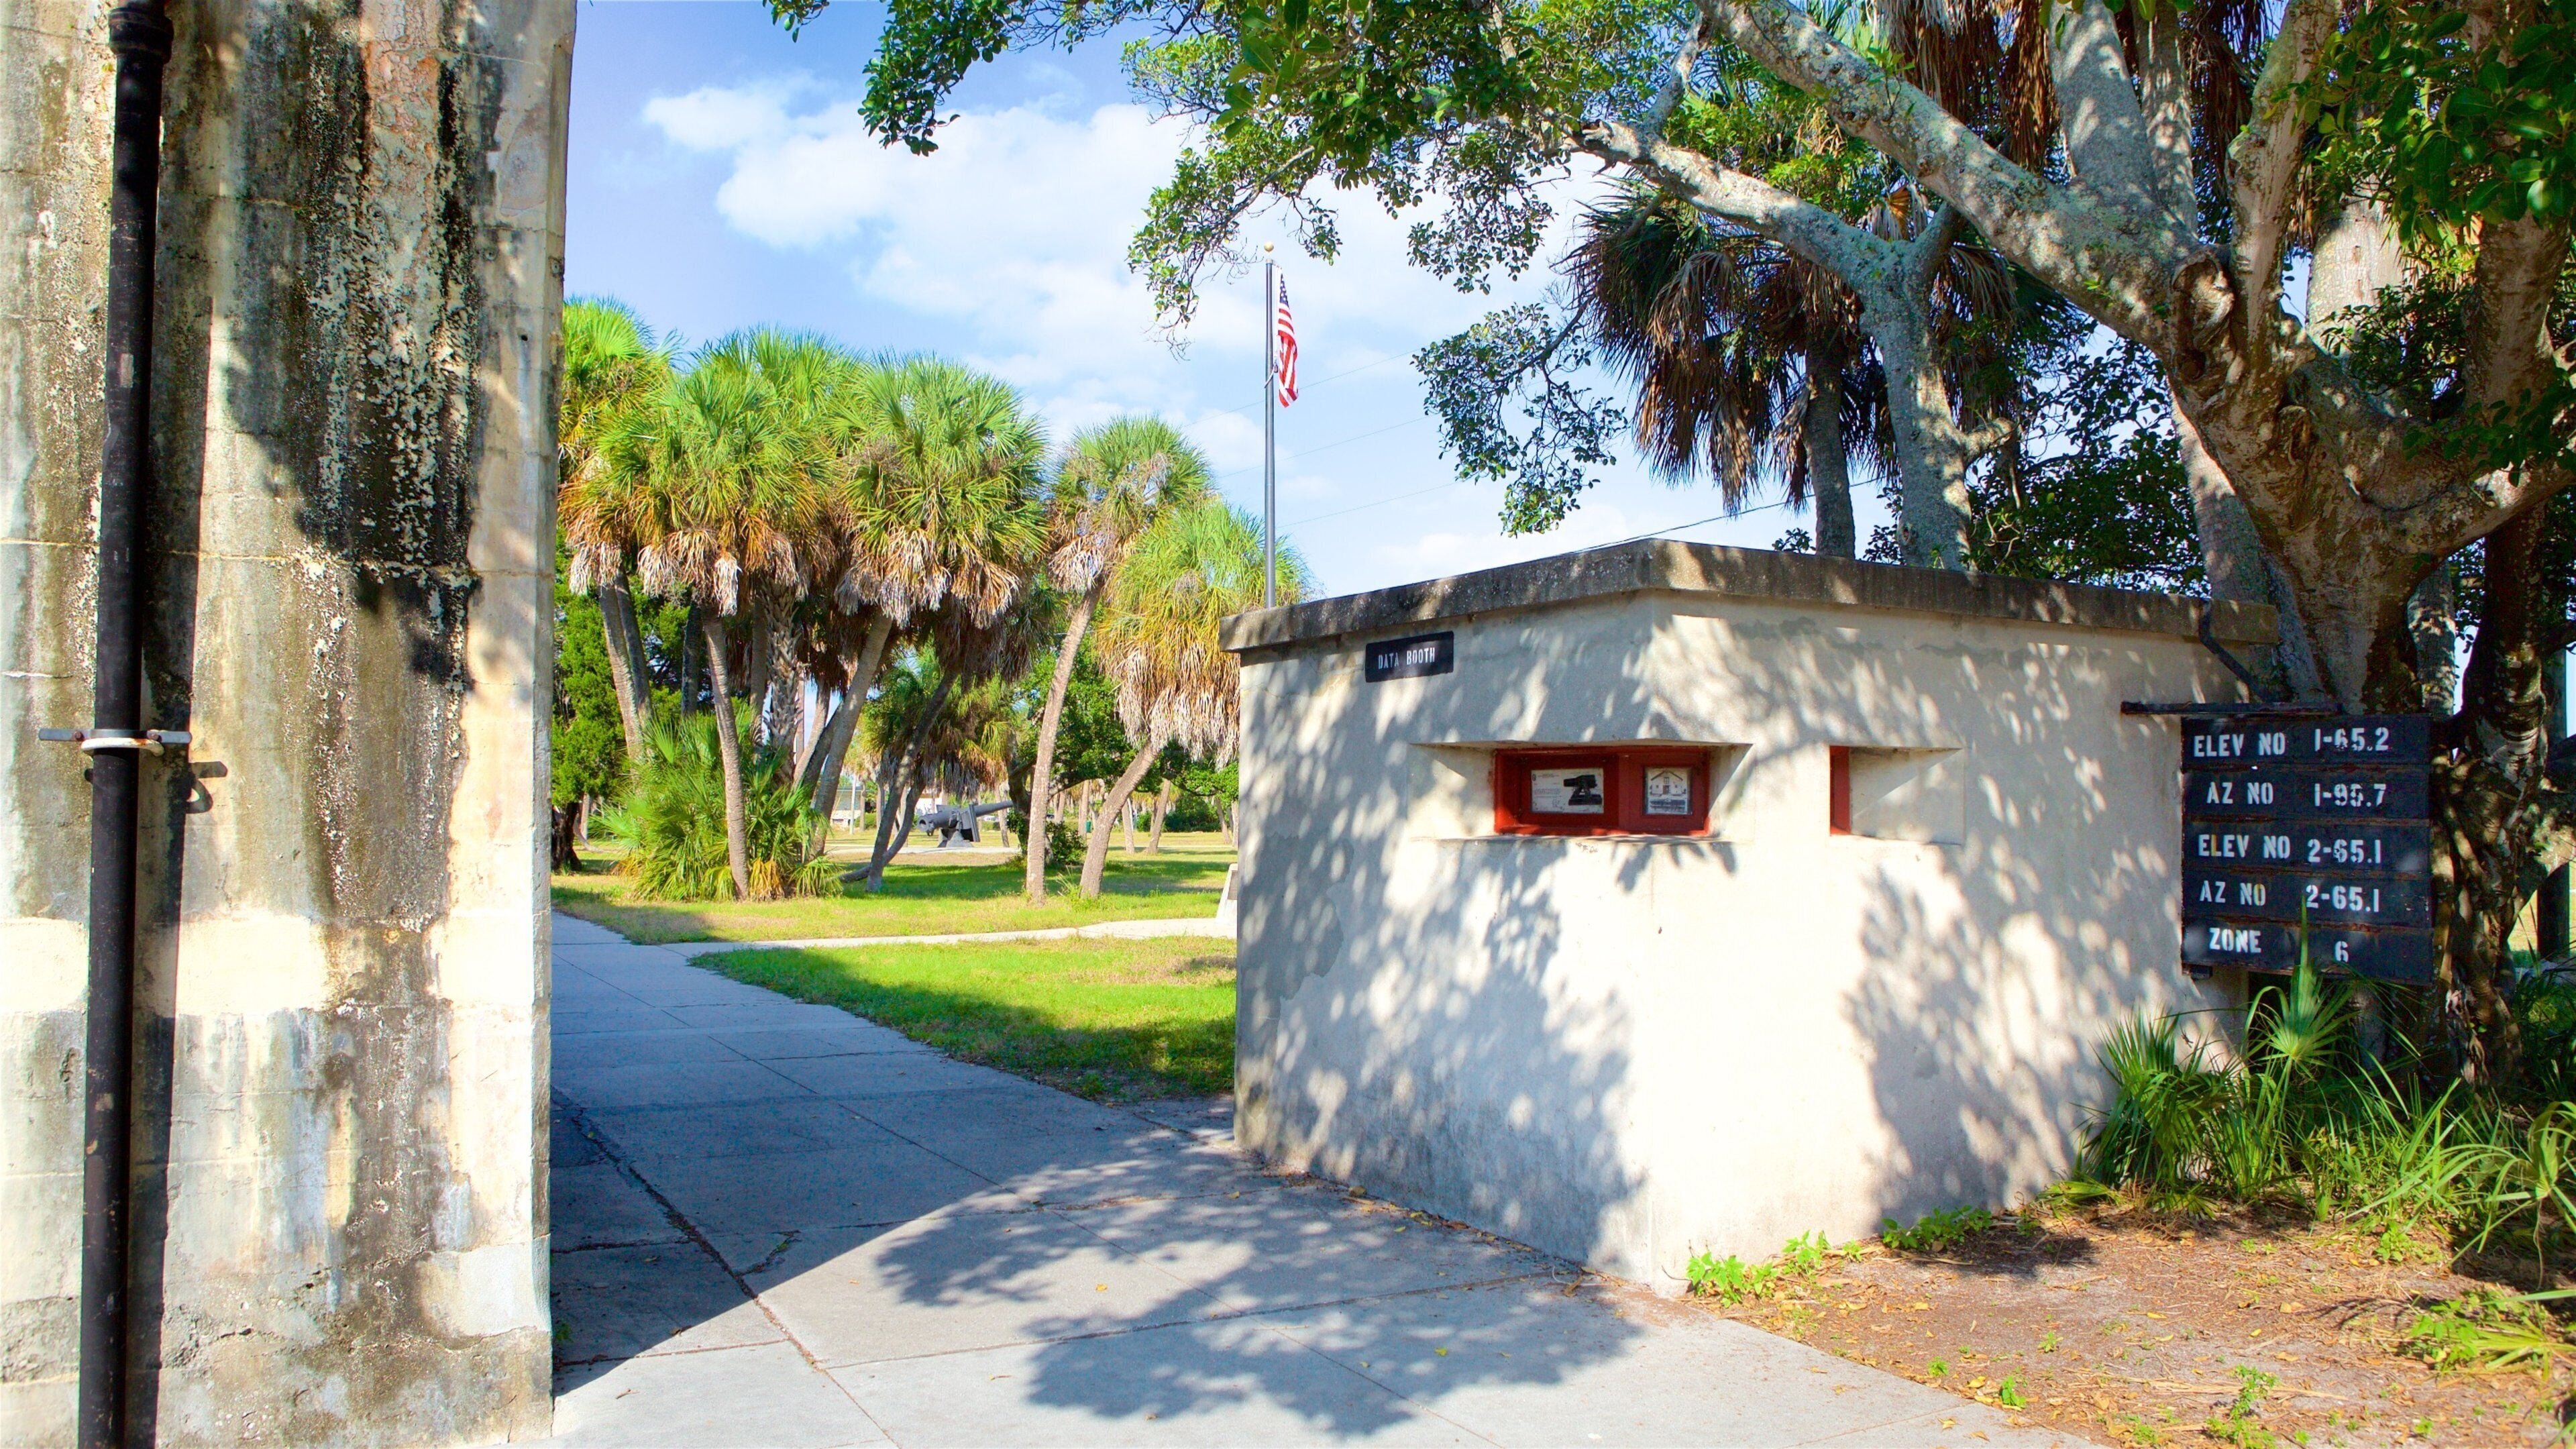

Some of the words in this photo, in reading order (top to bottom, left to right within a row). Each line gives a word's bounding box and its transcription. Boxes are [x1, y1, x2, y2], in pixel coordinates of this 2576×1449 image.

[1378, 652, 1399, 669] DATA
[1406, 647, 1436, 665] BOOTH
[2194, 734, 2244, 757] ELEV
[2258, 733, 2286, 755] NO
[2314, 727, 2389, 751] 1-65.2
[2206, 782, 2233, 804] AZ
[2247, 782, 2273, 804] NO
[2198, 835, 2249, 857] ELEV
[2263, 836, 2290, 859] NO
[2307, 839, 2381, 864] 2-65.1
[2200, 880, 2226, 903] AZ
[2240, 883, 2266, 906] NO
[2306, 884, 2379, 913] 2-65.1
[2209, 928, 2261, 953] ZONE
[2334, 941, 2349, 963] 6
